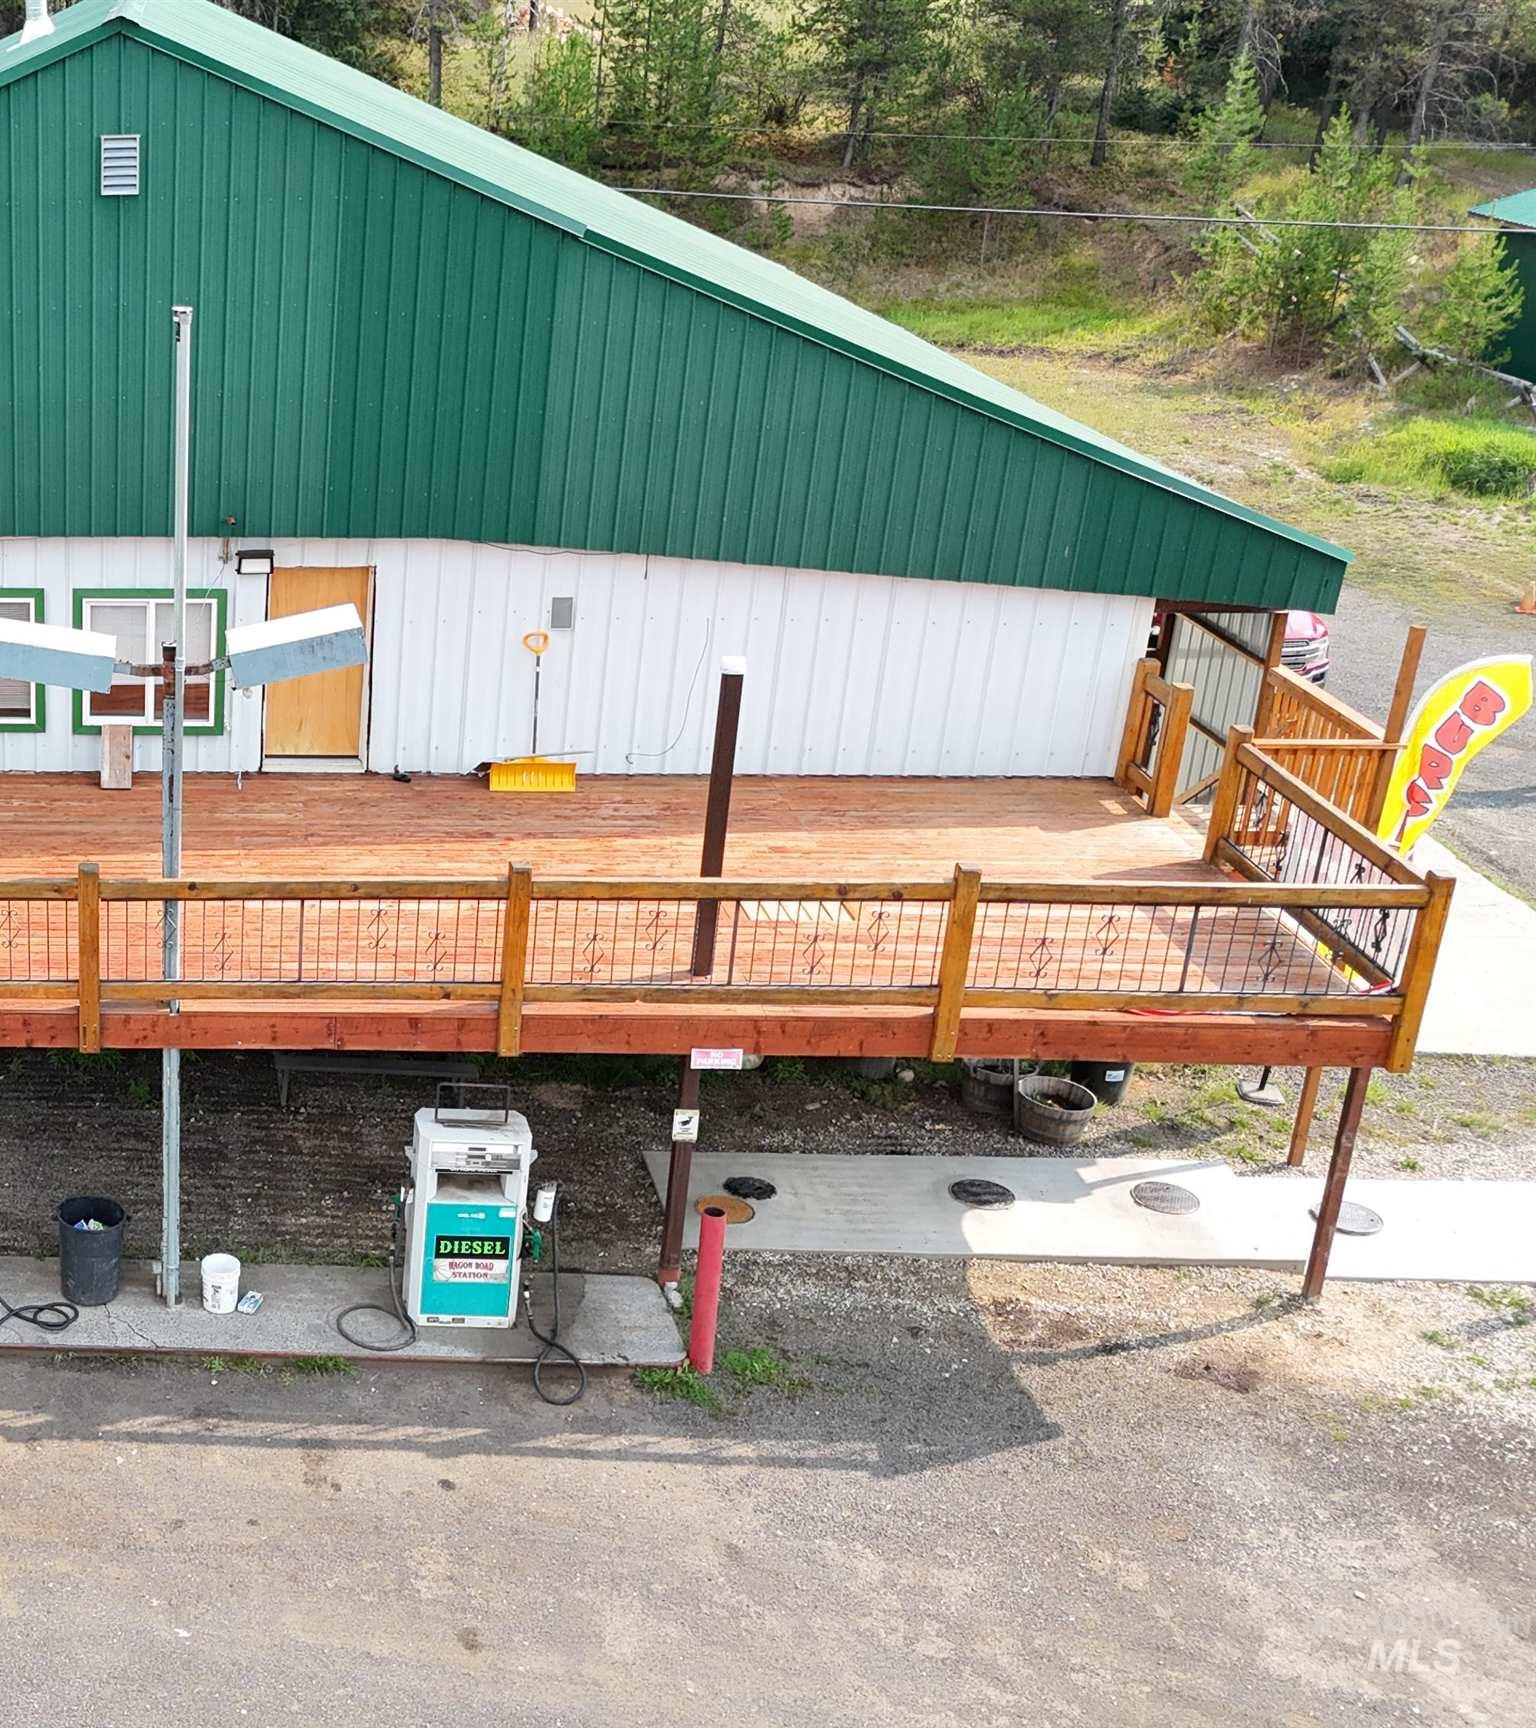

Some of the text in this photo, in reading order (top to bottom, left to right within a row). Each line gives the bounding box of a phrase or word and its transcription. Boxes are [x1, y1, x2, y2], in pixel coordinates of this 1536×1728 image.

[439, 1240, 506, 1255] DIESEL
[448, 1261, 494, 1271] WAGON ROAD
[452, 1271, 489, 1279] STATION
